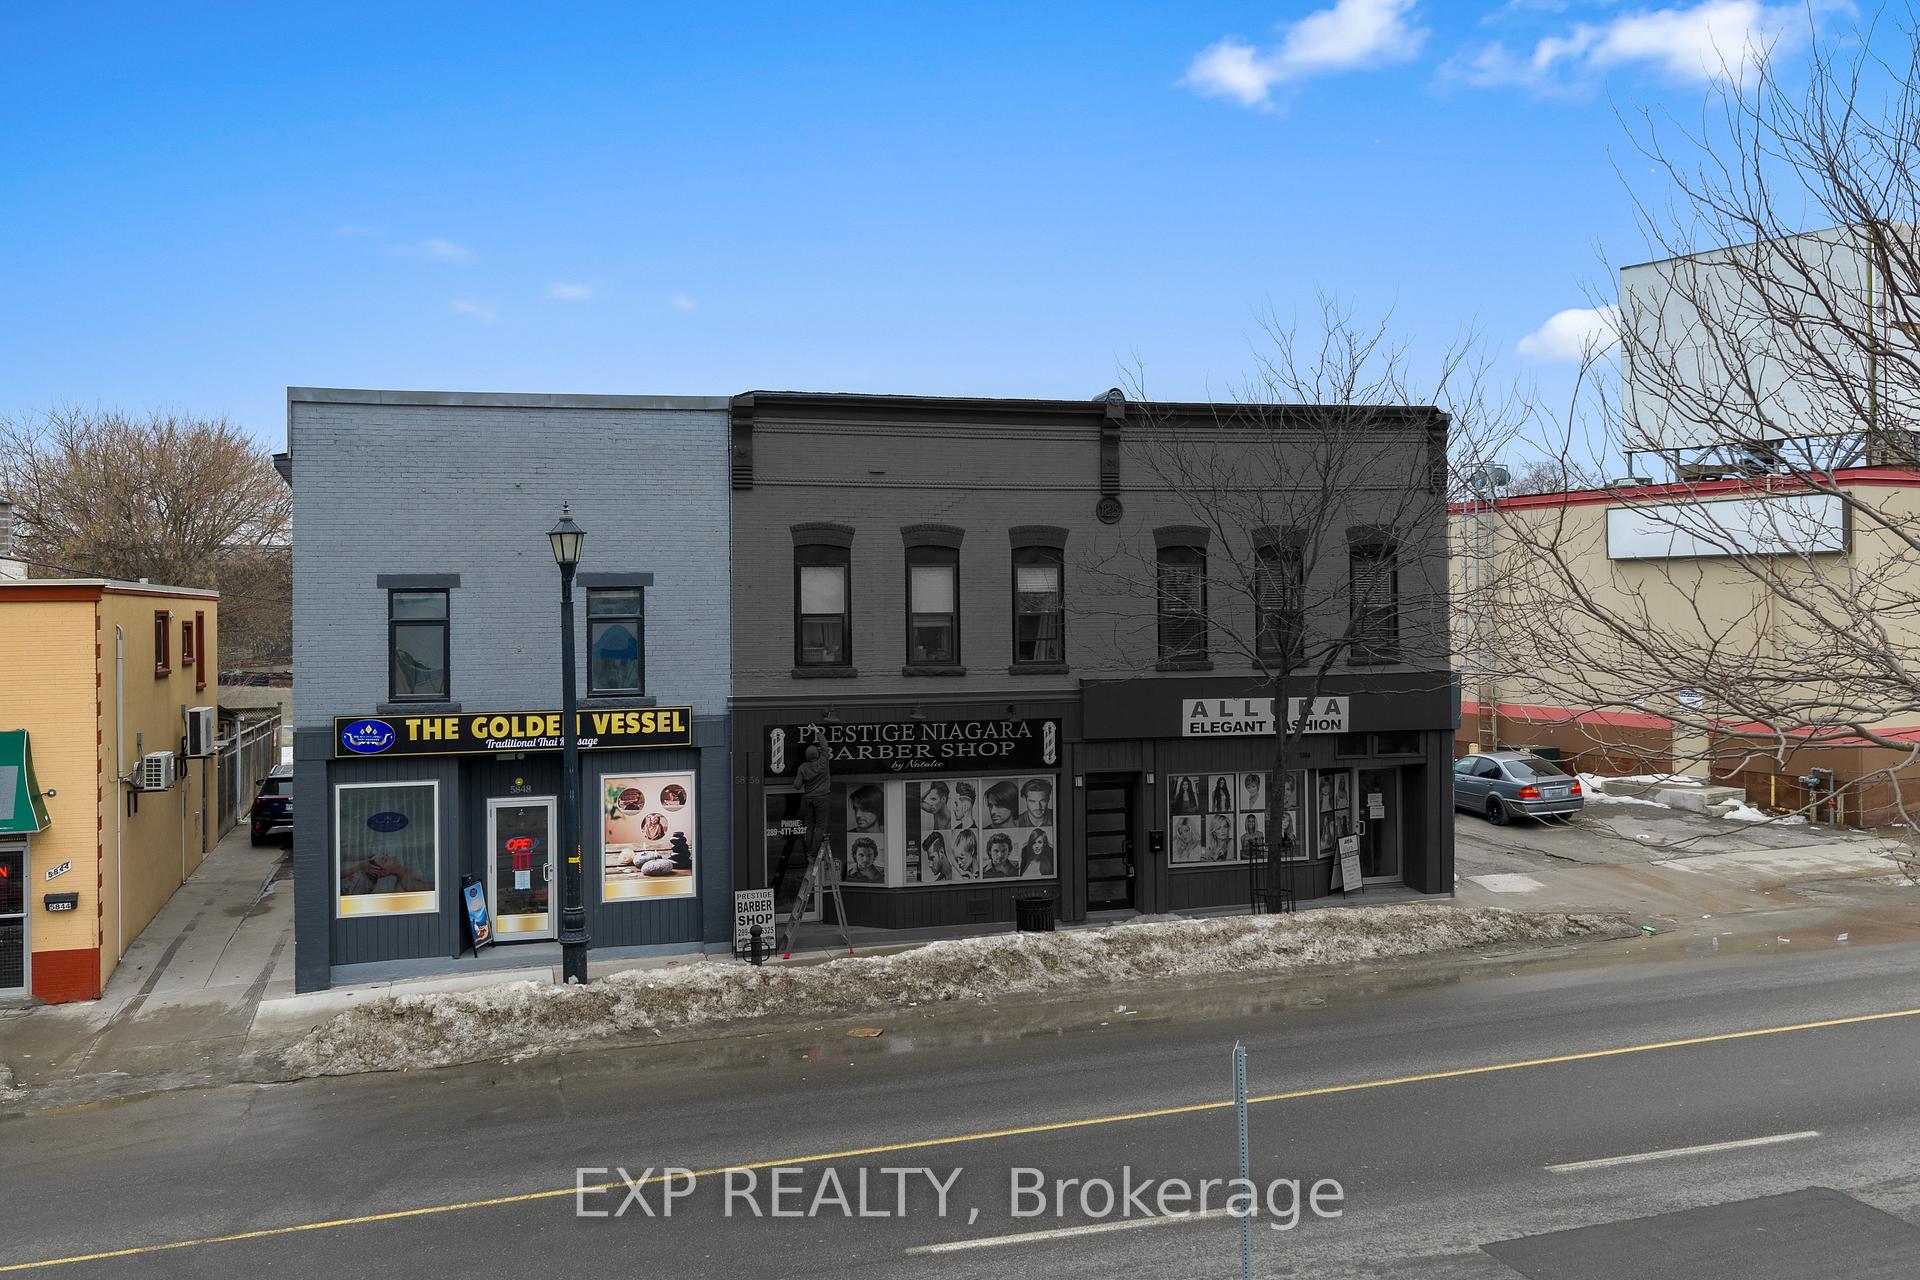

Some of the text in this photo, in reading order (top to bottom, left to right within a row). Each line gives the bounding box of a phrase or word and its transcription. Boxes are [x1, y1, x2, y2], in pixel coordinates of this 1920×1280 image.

[405, 718, 459, 741] THE
[592, 711, 685, 735] VESSEL
[797, 721, 1033, 743] PRESTIGE NIAGARA
[1189, 719, 1342, 734] ELEGANT SHION
[485, 736, 599, 748] Traditional Thai sage
[941, 741, 1016, 758] SHOP
[891, 761, 905, 771] by
[510, 785, 532, 794] 5848
[781, 819, 803, 828] PHONE:
[506, 837, 537, 851] OPEN
[737, 890, 772, 900] PRESTIGE
[737, 900, 773, 913] BARBER
[738, 913, 773, 926] SHOP
